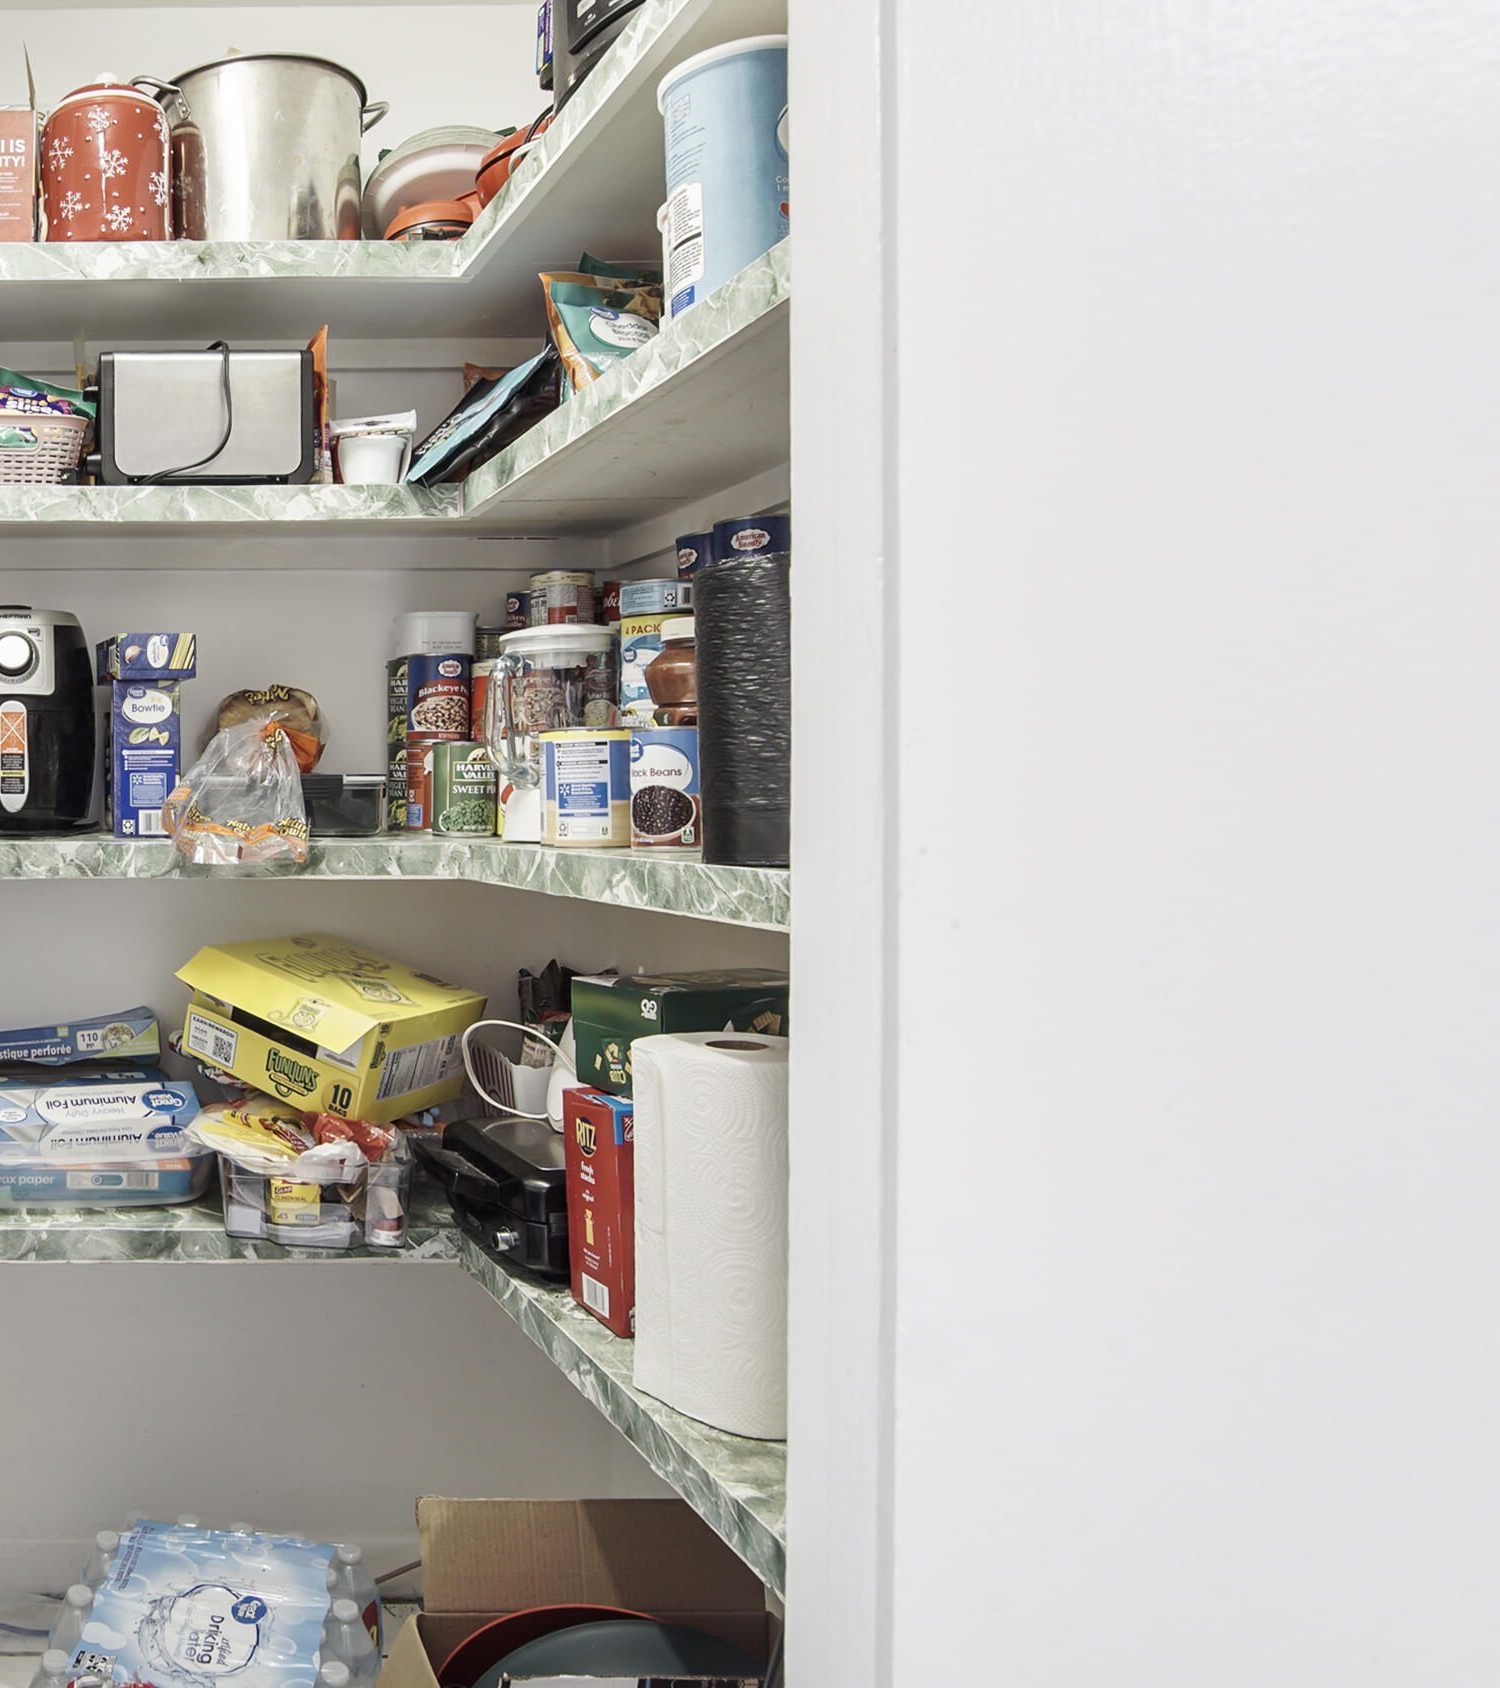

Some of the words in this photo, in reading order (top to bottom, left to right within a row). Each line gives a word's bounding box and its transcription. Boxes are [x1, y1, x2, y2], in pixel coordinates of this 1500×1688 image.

[10, 139, 26, 153] IS
[735, 532, 766, 542] American
[738, 540, 762, 548] Beauty
[625, 625, 630, 634] 4
[631, 624, 661, 634] PACK
[419, 684, 459, 697] Blackeye
[132, 704, 165, 712] Bowtie
[650, 768, 682, 777] Beans
[452, 785, 484, 794] SWEET
[81, 1033, 98, 1043] 110
[31, 1045, 72, 1058] perforée
[70, 1096, 136, 1106] Aluminum
[150, 1097, 182, 1106] Great
[332, 1084, 352, 1110] 10
[46, 1100, 68, 1109] Foil
[66, 1109, 89, 1117] Duty
[328, 1104, 348, 1117] BAGS
[576, 1118, 597, 1150] RITZ
[51, 1138, 73, 1150] Foil
[76, 1133, 142, 1147] Aluminum
[19, 1176, 55, 1186] paper
